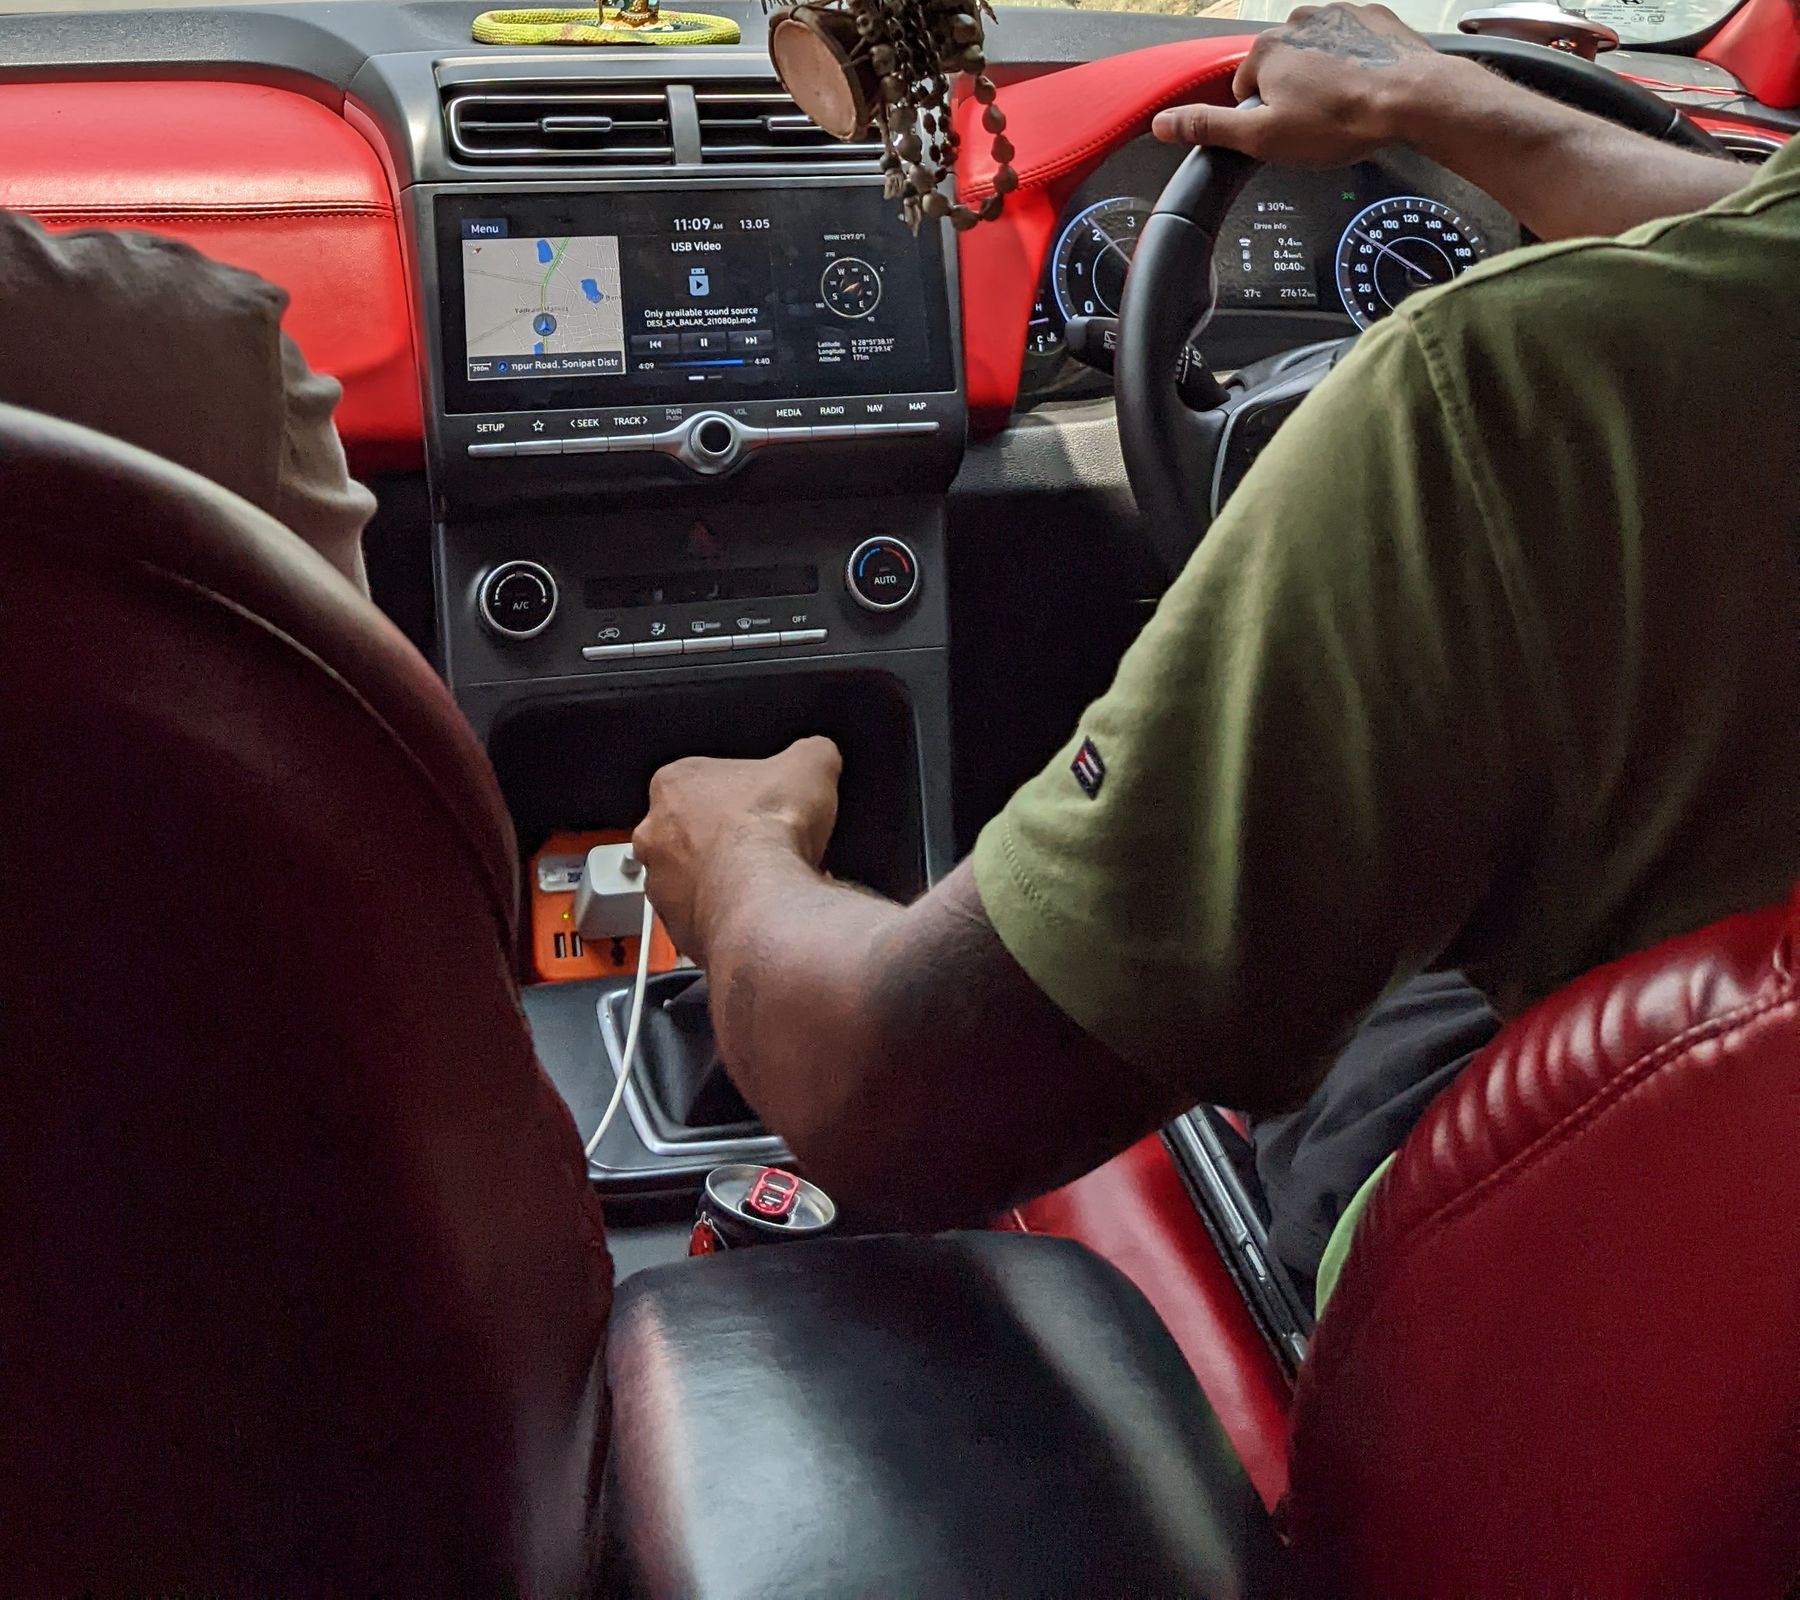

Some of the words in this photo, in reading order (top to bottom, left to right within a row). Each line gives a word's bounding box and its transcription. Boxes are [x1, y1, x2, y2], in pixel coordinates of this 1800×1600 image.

[1127, 216, 1135, 228] 3
[1403, 214, 1419, 223] 120
[673, 218, 711, 231] 11:09
[739, 218, 770, 230] 13.05
[1382, 220, 1399, 229] 100
[1425, 220, 1442, 229] 140
[471, 224, 499, 234] Menu
[1092, 229, 1101, 241] 2
[1369, 230, 1382, 239] 80
[1442, 232, 1458, 241] 160
[671, 242, 692, 252] USB
[693, 241, 722, 251] Video
[1360, 244, 1373, 254] 60
[1454, 247, 1471, 257] 180
[1075, 262, 1082, 275] 1
[1354, 263, 1368, 273] 40
[1358, 283, 1371, 292] 20
[1035, 303, 1042, 311] H
[1084, 300, 1094, 314] 0
[1368, 302, 1374, 311] 0
[644, 309, 663, 319] Only
[665, 308, 703, 318] available
[704, 307, 729, 316] sound
[731, 307, 759, 315] source
[1037, 335, 1043, 343] C
[562, 359, 596, 370] Sonipat
[598, 358, 618, 367] Distr
[820, 406, 845, 415] RADIO
[867, 404, 883, 412] NAV
[909, 402, 927, 410] MAP
[734, 407, 748, 415] VOL
[776, 409, 802, 418] MEDIA
[577, 418, 599, 427] SEEK
[613, 416, 641, 426] TRACK
[476, 423, 505, 432] SETUP
[874, 575, 897, 585] AUTO
[513, 601, 529, 610] A/C
[791, 615, 807, 623] OFF
